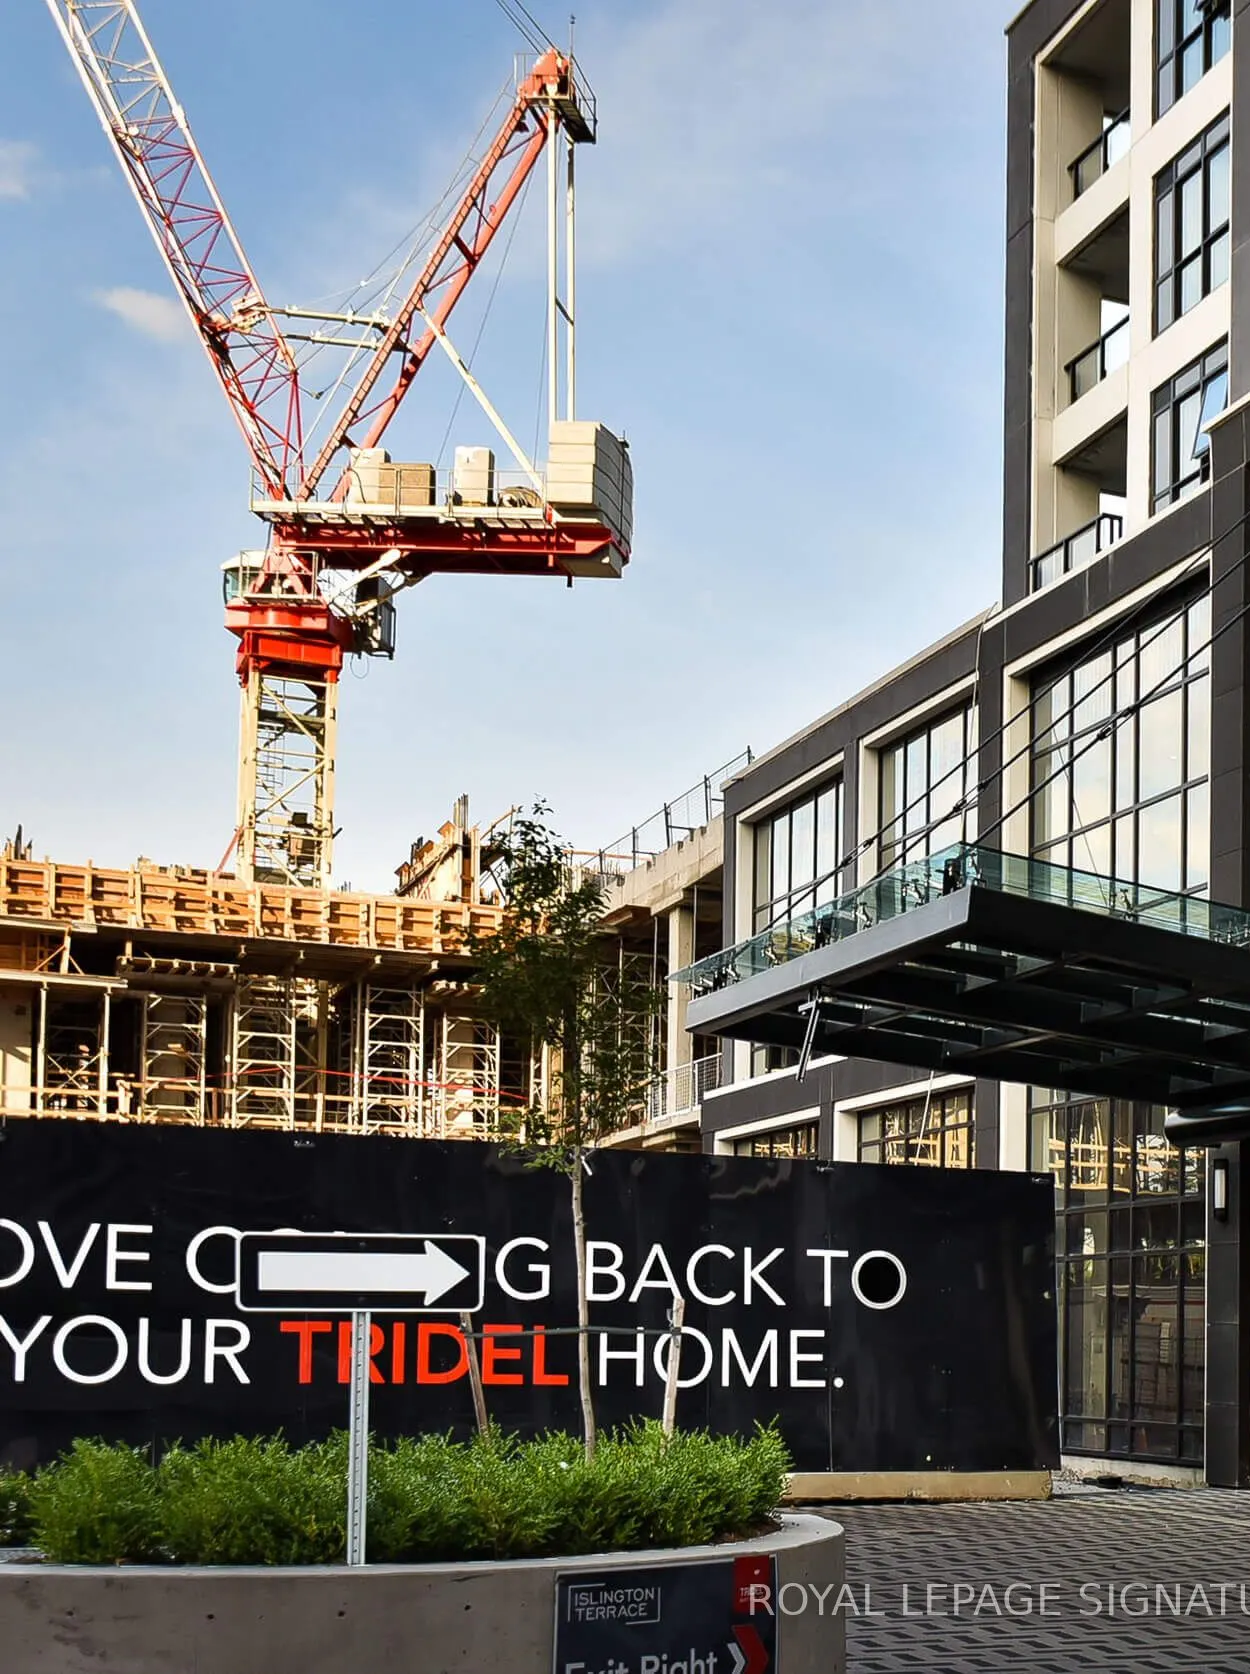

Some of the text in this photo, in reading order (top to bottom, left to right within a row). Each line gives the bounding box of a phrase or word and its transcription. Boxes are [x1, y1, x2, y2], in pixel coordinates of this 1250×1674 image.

[585, 1240, 786, 1306] BACK
[806, 1247, 907, 1310] TO
[0, 1314, 845, 1389] YOUR TRIDEL HOME.
[574, 1587, 655, 1607] ISLINGTON
[574, 1602, 649, 1622] TERRACE
